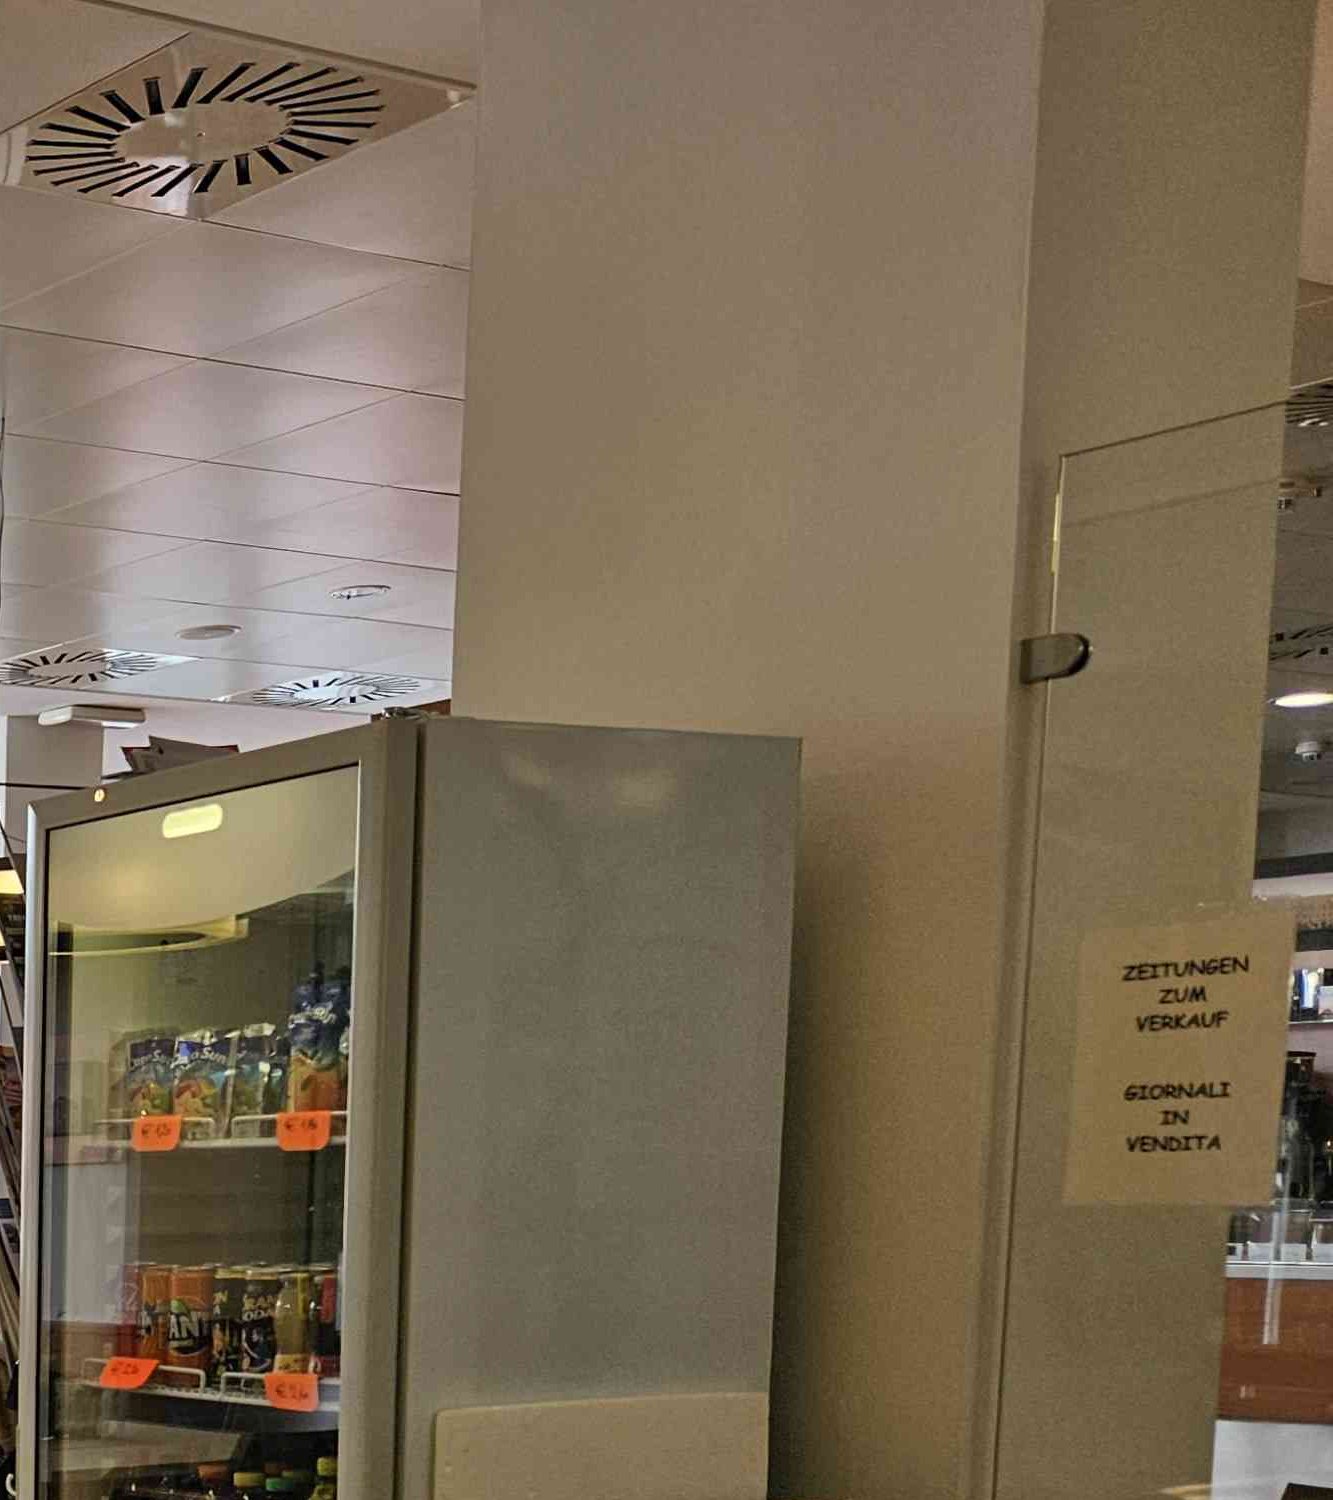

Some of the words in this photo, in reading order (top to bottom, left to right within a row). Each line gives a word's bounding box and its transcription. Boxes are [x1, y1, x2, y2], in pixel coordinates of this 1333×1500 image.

[1121, 956, 1250, 981] ZEITUNGEN
[1158, 987, 1207, 1004] ZUM
[1135, 1010, 1230, 1032] VERKAUF
[1123, 1081, 1231, 1101] GIORNALI
[1158, 1109, 1190, 1126] IN
[1125, 1136, 1222, 1153] VENDITA
